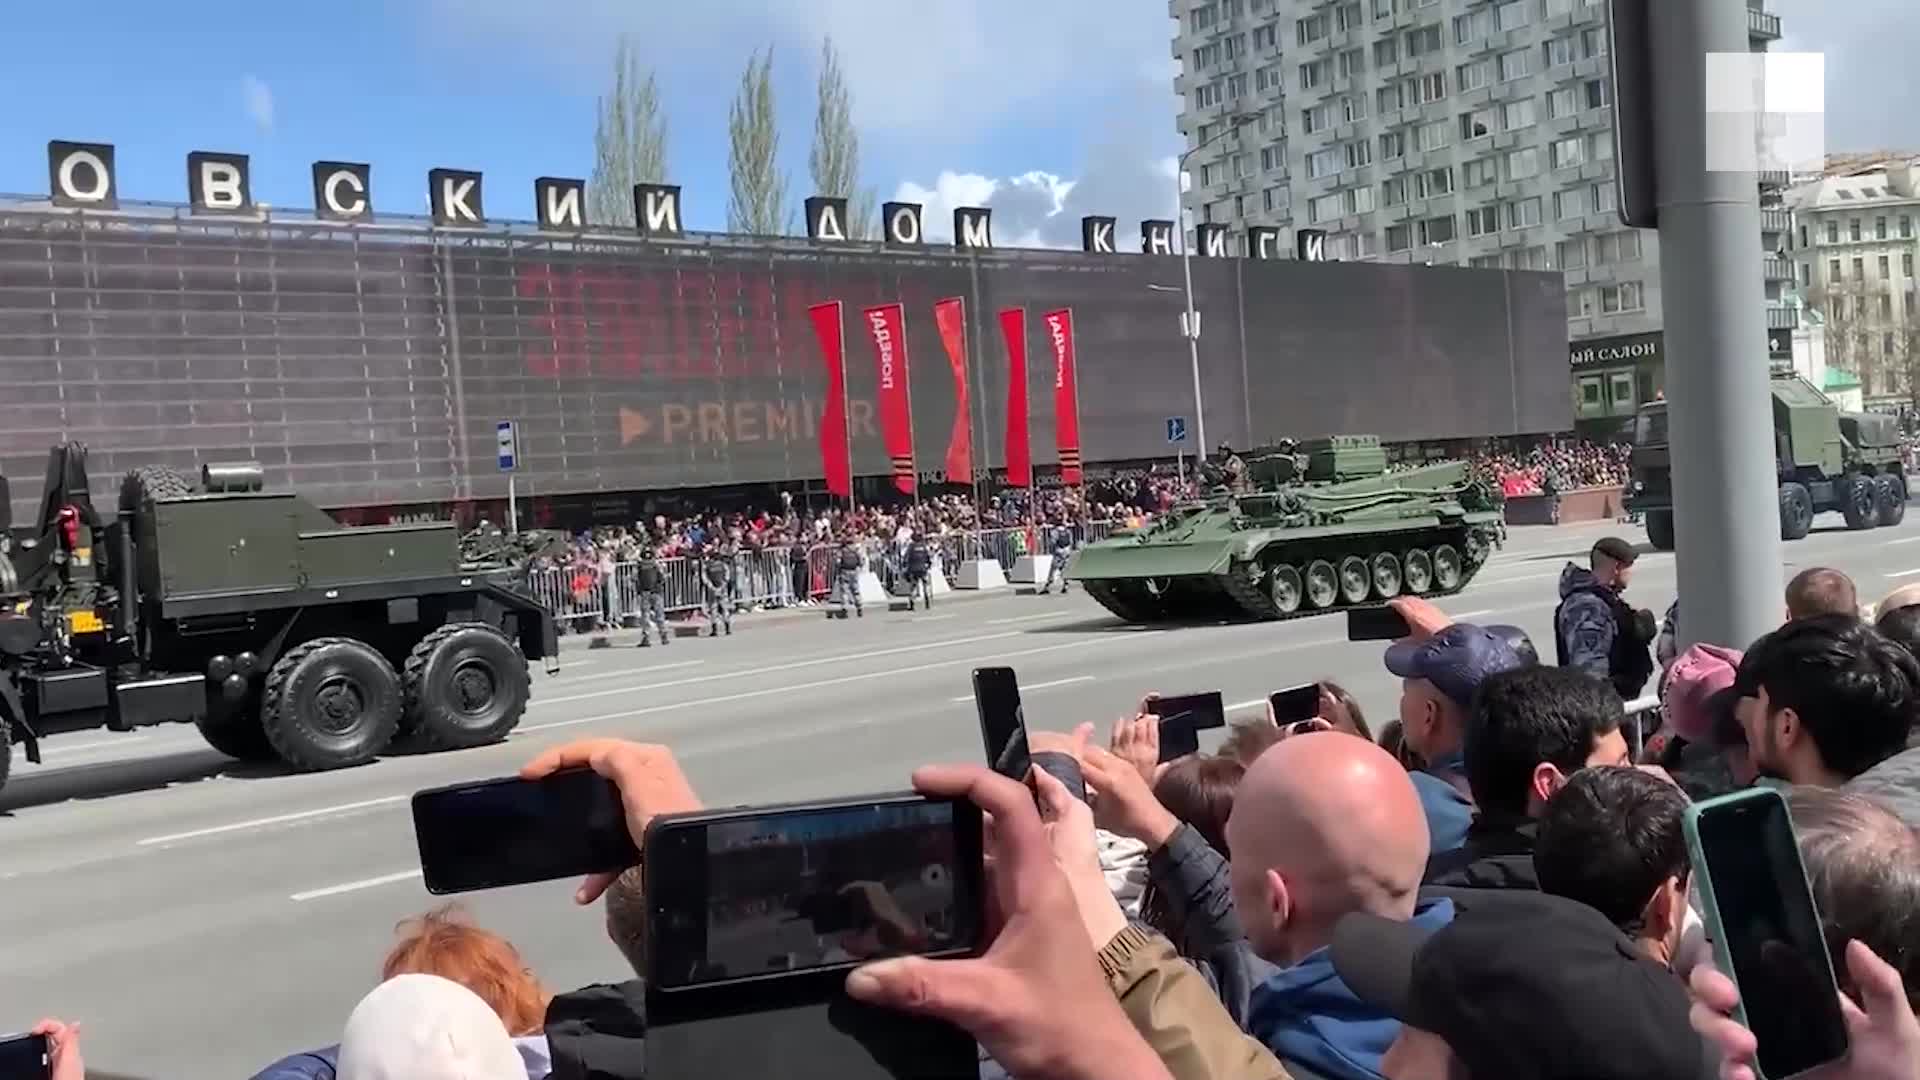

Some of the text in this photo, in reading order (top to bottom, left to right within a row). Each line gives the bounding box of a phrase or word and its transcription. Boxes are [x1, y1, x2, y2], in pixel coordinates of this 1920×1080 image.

[58, 150, 1325, 262] ОВСКИЙ ДОМ КНИГИ
[1598, 343, 1656, 360] САЛОН
[661, 401, 876, 444] PREMIR
